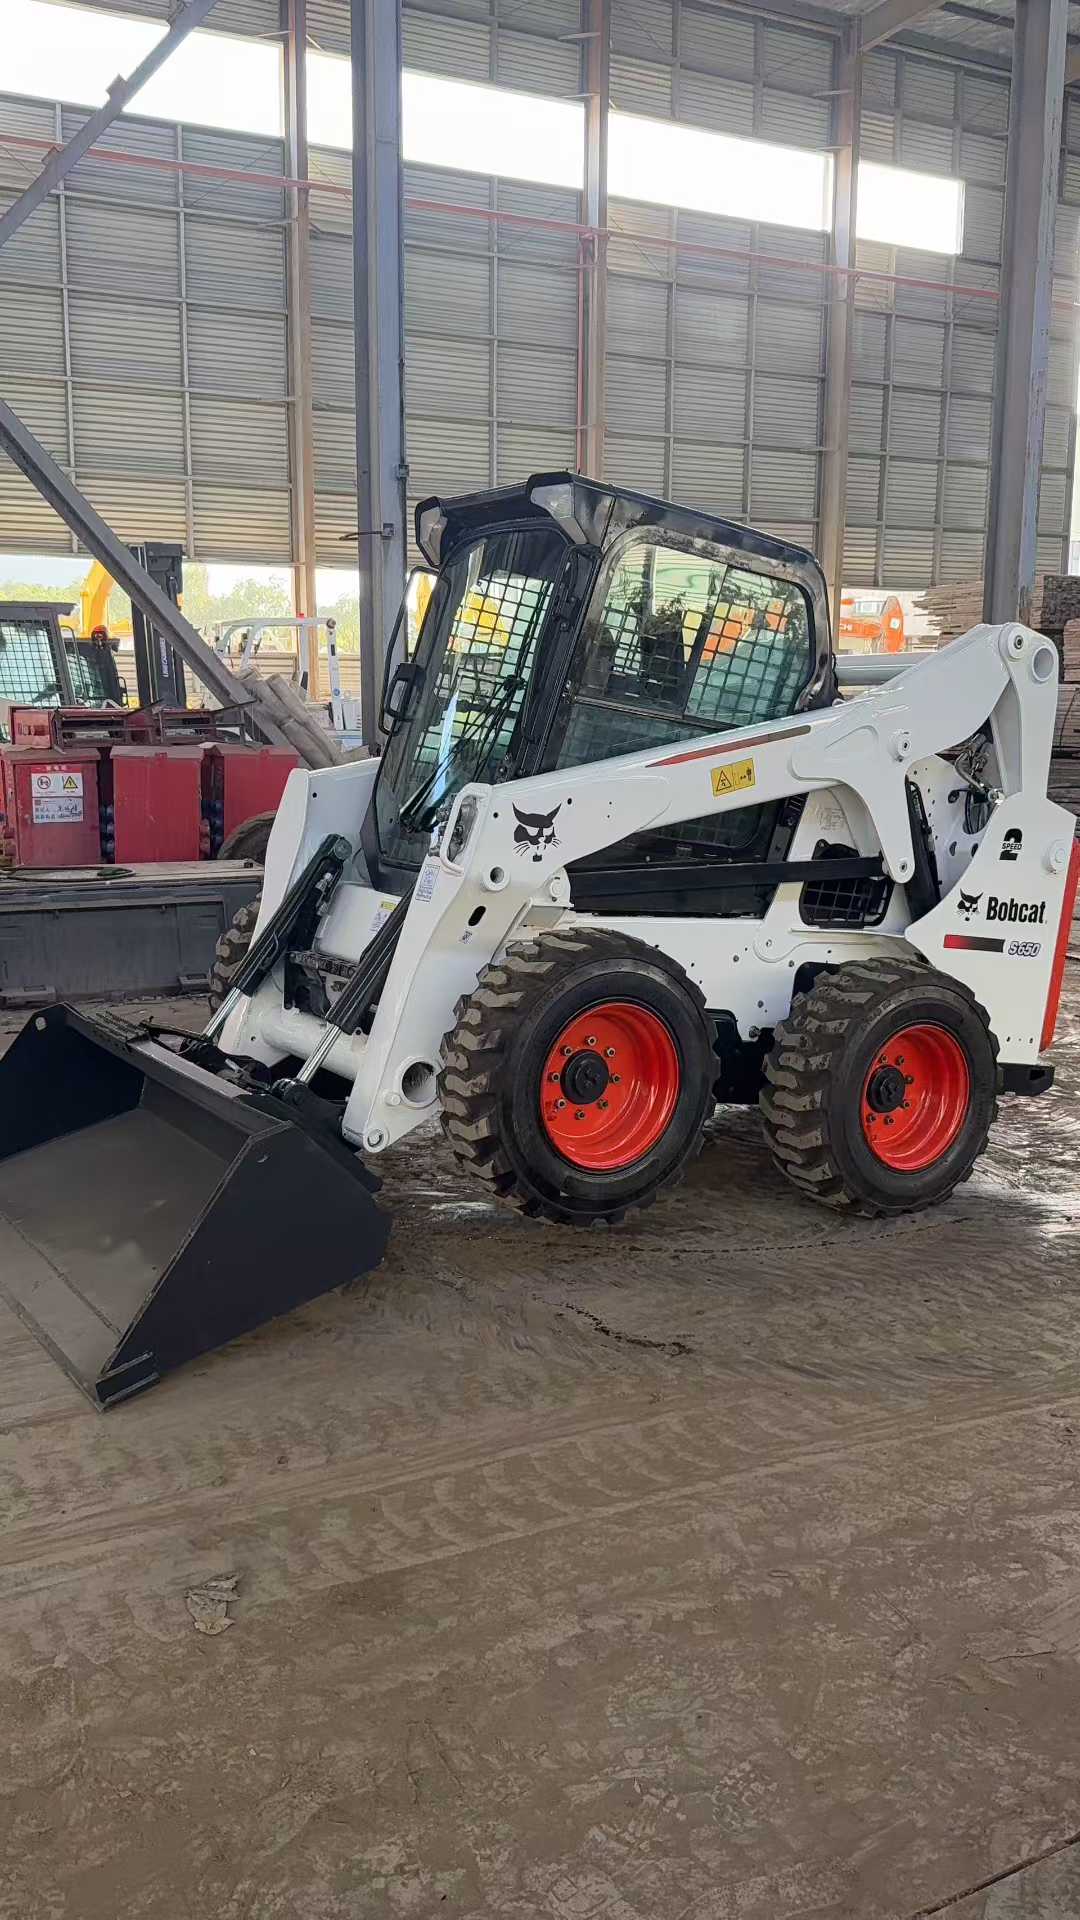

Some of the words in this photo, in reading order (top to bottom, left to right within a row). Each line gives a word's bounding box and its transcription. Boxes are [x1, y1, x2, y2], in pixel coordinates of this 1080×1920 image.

[999, 828, 1023, 861] 2
[1001, 842, 1023, 850] SPEED
[986, 896, 1046, 924] Bobcat
[1008, 940, 1041, 957] S650
